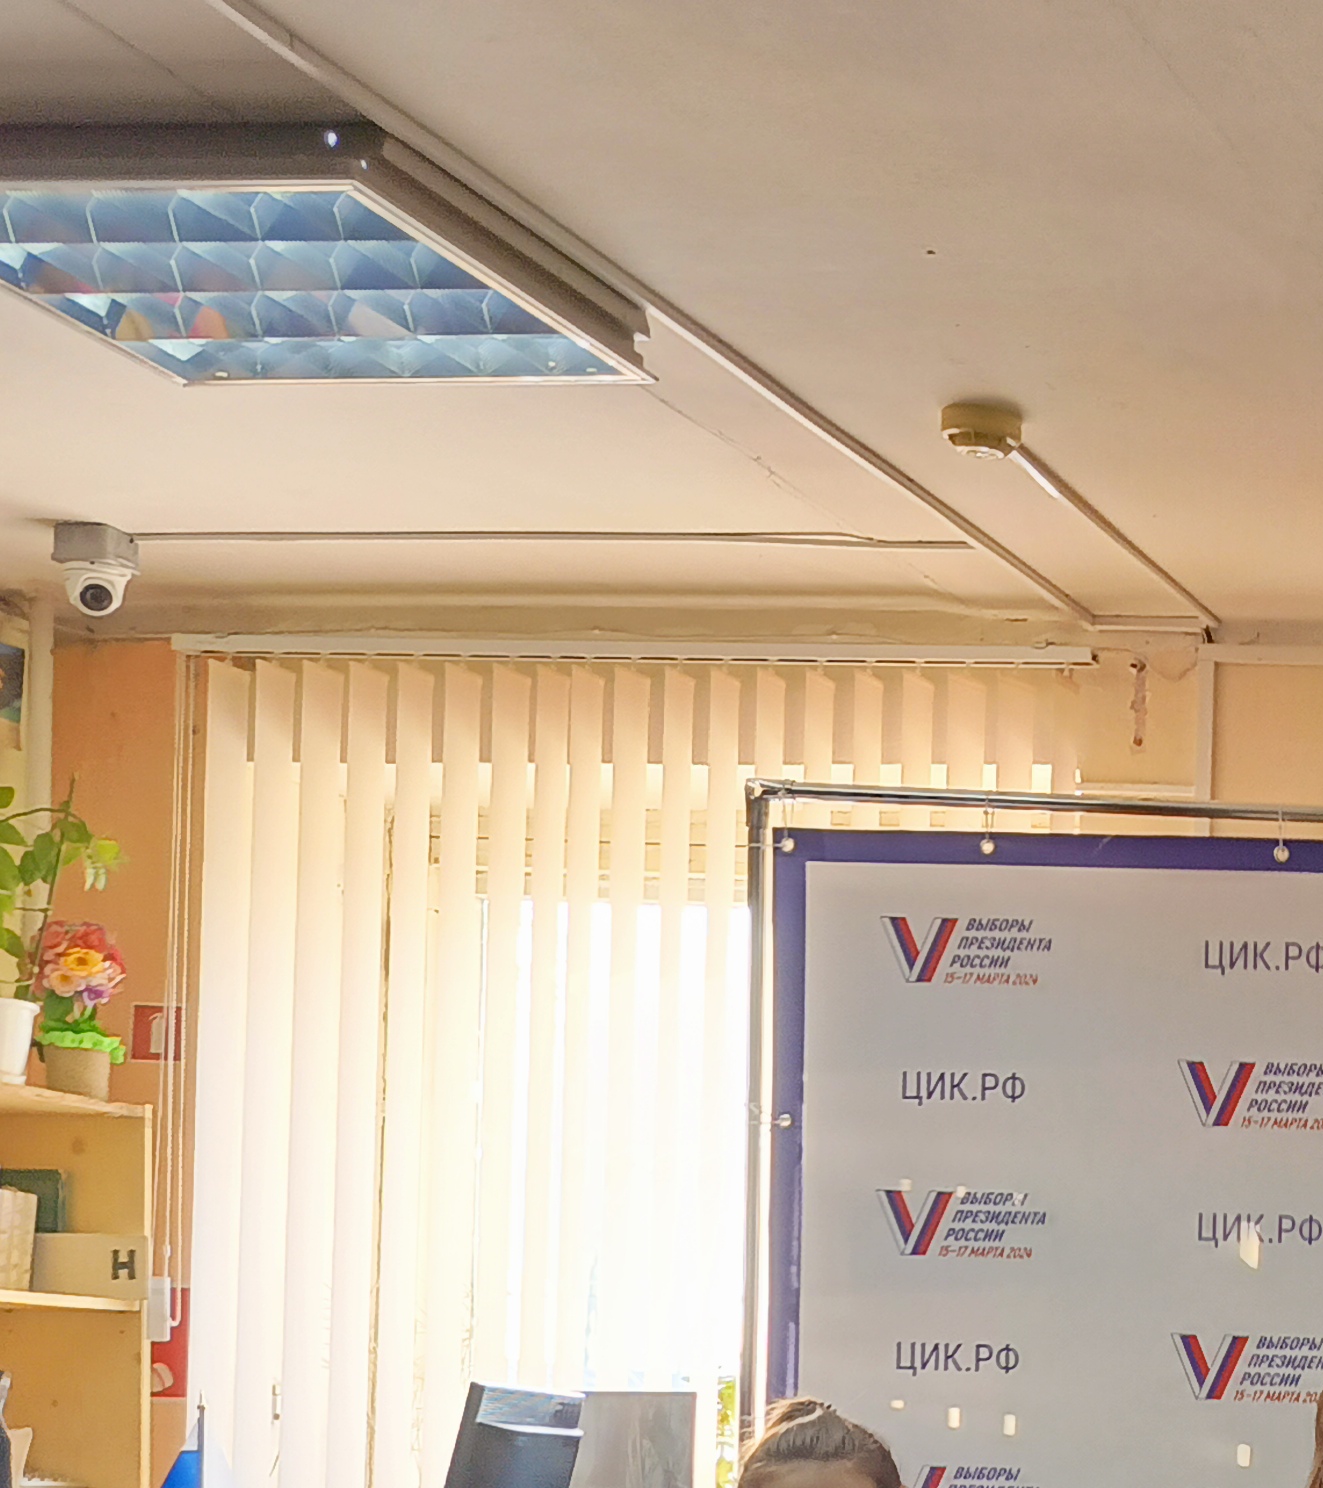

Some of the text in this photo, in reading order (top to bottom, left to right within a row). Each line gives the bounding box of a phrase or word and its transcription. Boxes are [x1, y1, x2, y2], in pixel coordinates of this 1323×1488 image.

[965, 918, 1033, 933] ВЫБОРЫ
[957, 936, 1052, 953] ПРЕЗИДЕНТА
[949, 954, 1011, 969] РОССИИ
[974, 973, 1010, 985] МАРТА
[1011, 974, 1039, 986] 2024
[902, 1070, 1026, 1107] ЦИК.РФ
[1246, 1098, 1309, 1114] РОССИИ
[1272, 1117, 1308, 1129] МАРТА
[951, 1210, 1047, 1226] ПРЕЗИДЕНТА
[944, 1228, 1005, 1243] РОССИИ
[968, 1247, 1005, 1259] МАРТА
[1006, 1247, 1032, 1260] 2024
[1255, 1336, 1323, 1352] ВЫБОРЫ
[895, 1341, 1019, 1377] ЦИК.РФ
[1240, 1372, 1302, 1388] РОССИИ
[1264, 1391, 1301, 1404] МАРТА
[953, 1467, 1021, 1482] ВЫБОРЫ
